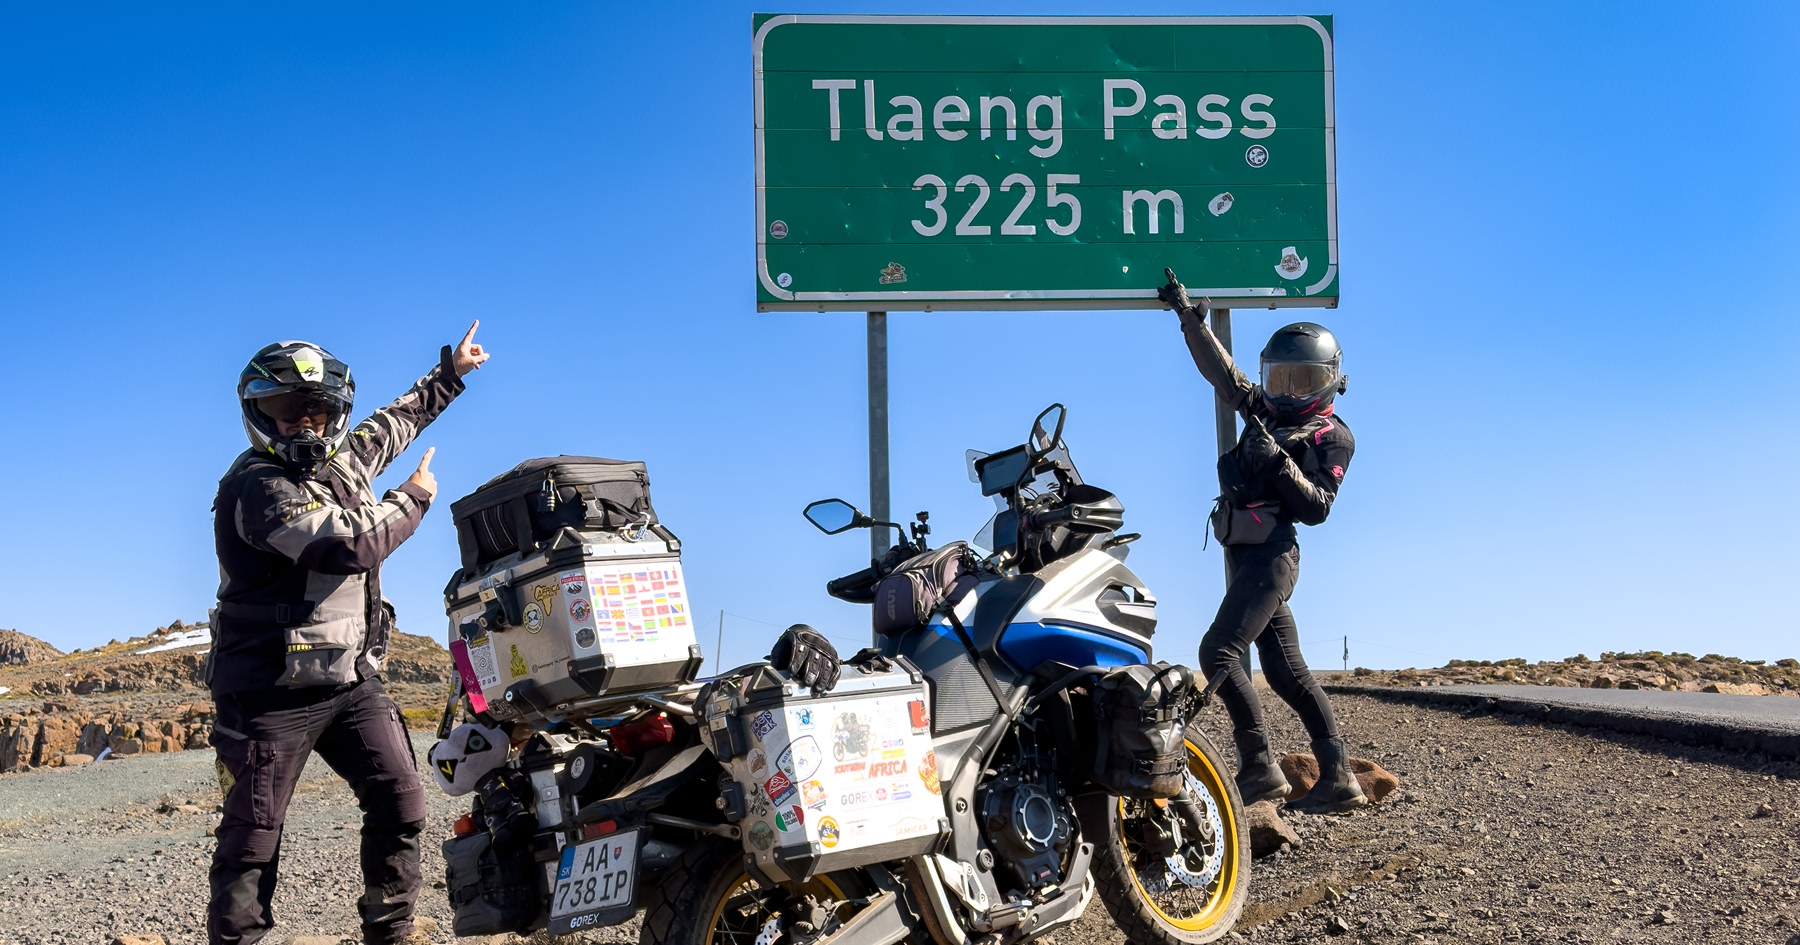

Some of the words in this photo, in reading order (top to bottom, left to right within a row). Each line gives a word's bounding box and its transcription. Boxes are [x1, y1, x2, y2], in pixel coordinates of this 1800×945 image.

[812, 79, 1062, 158] Tlaeng
[1103, 79, 1276, 140] Pass
[911, 174, 1082, 236] 3225
[1123, 189, 1184, 234] m
[834, 761, 866, 774] SOUTHERN
[868, 759, 907, 779] AFRICA
[841, 791, 873, 805] GOREX
[561, 867, 571, 877] SK
[582, 843, 609, 875] AA
[558, 870, 628, 910] 738IP
[570, 912, 600, 929] GOREX
